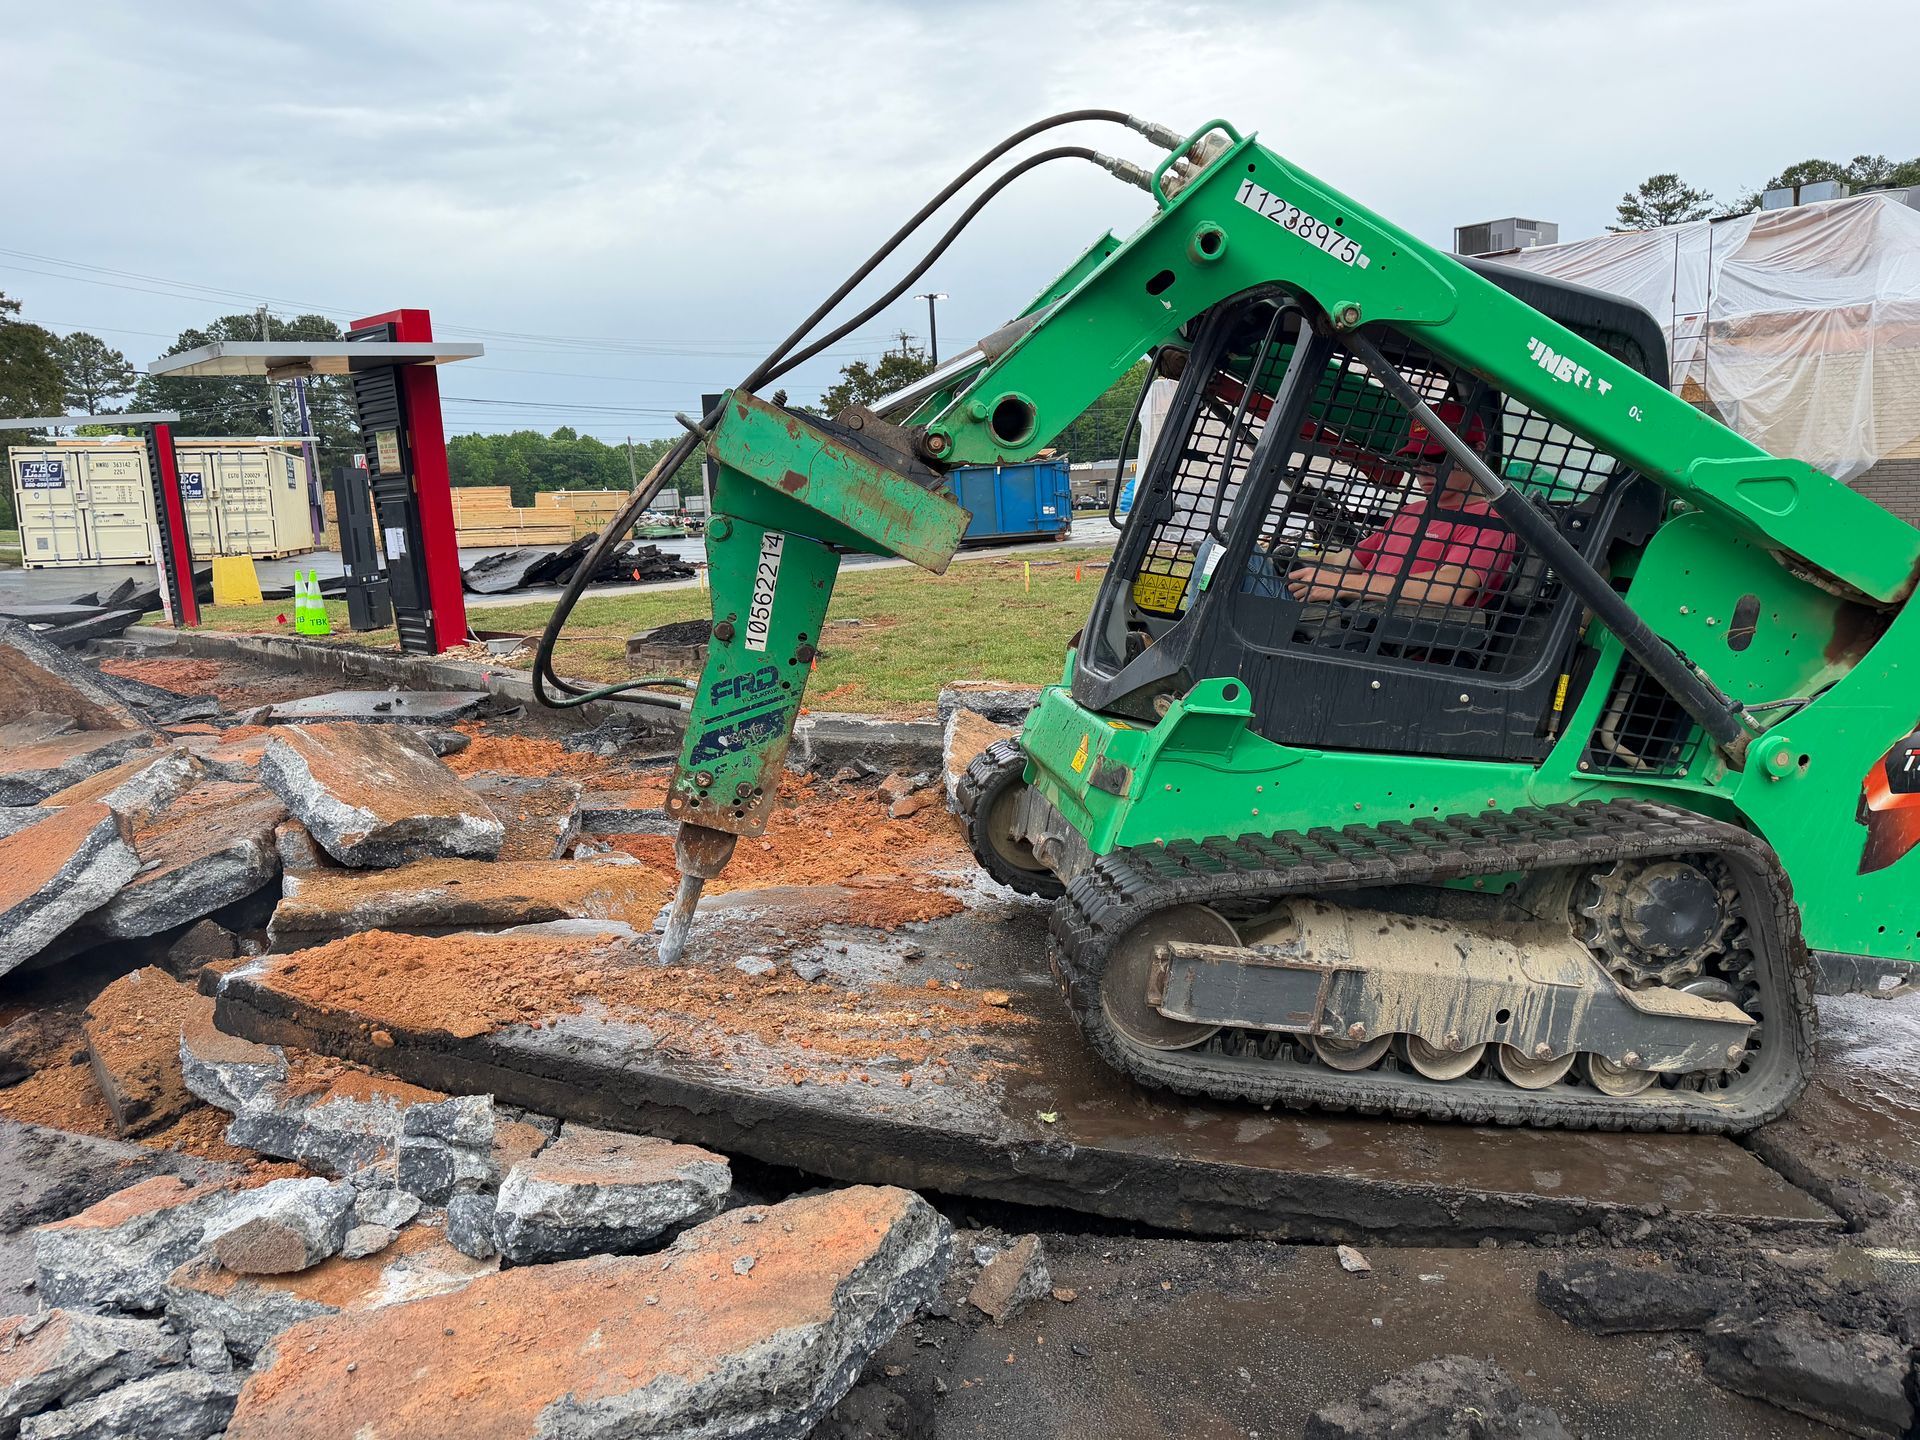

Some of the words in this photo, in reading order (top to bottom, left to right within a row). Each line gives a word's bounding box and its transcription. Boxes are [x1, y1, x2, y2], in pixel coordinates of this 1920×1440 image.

[1242, 183, 1359, 263] 11238975
[30, 463, 59, 473] TEG
[1070, 461, 1093, 470] Donald's
[180, 473, 200, 484] EG
[747, 534, 783, 646] 10562214
[310, 618, 328, 626] TBK
[711, 665, 779, 706] FRD
